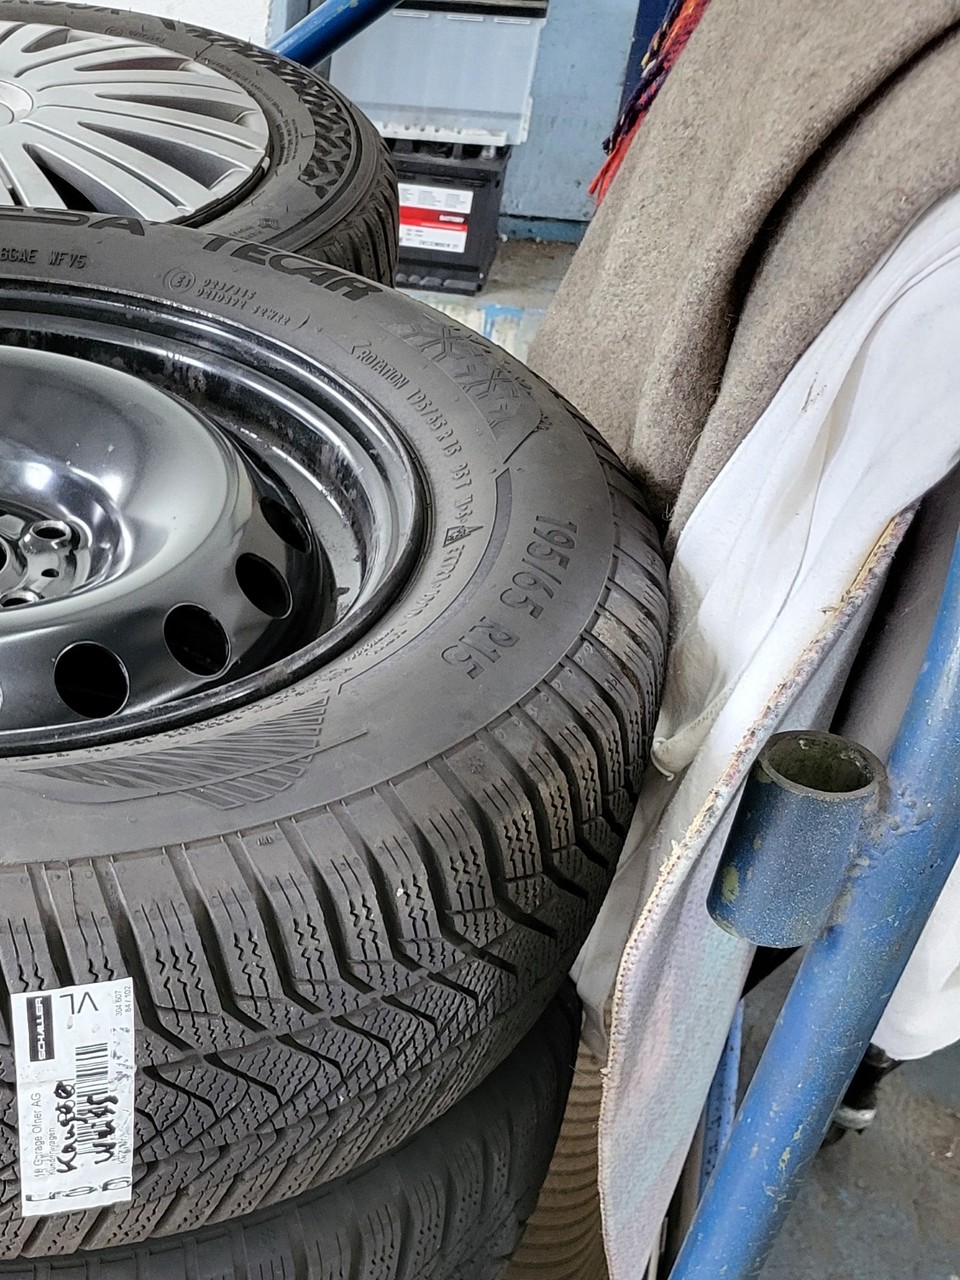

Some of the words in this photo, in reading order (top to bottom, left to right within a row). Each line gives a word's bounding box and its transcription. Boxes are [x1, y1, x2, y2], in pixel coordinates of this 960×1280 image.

[202, 233, 384, 302] TECAR
[357, 349, 410, 390] ROTATION
[500, 515, 578, 619] 195/65
[36, 997, 47, 1060] SCHALLER
[59, 991, 99, 1015] VL
[31, 1092, 41, 1107] AG
